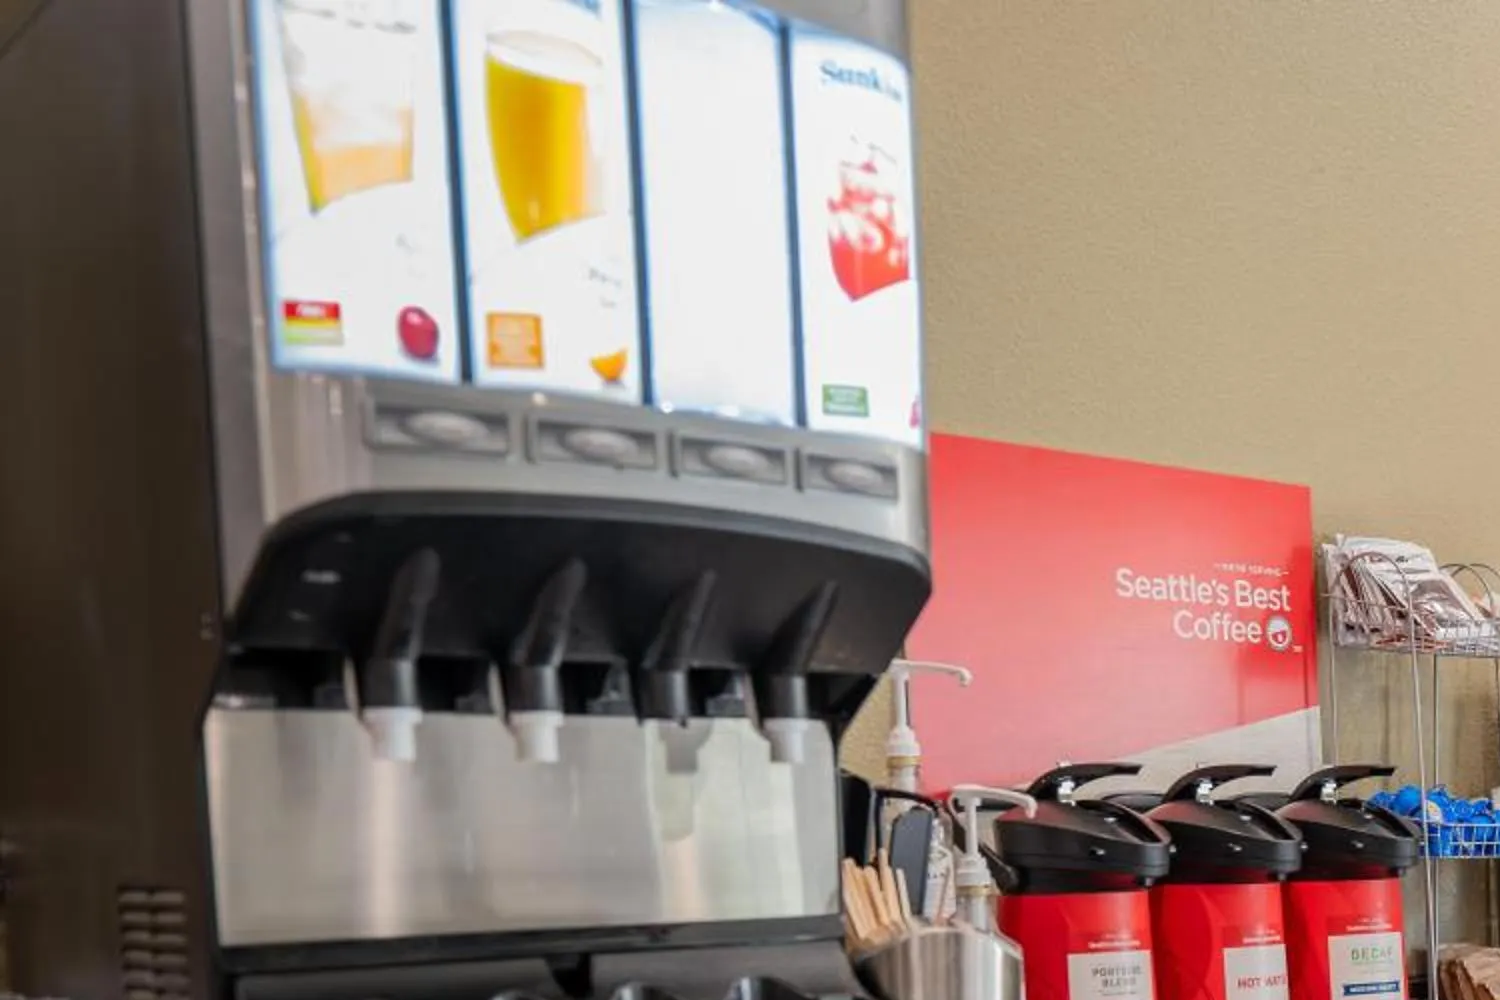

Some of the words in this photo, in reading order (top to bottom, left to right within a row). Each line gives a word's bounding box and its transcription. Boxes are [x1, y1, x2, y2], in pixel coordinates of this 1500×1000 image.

[1116, 567, 1229, 606] Seattle's
[1234, 580, 1291, 612] Best
[1173, 609, 1263, 643] Coffee
[1237, 977, 1260, 989] HOT
